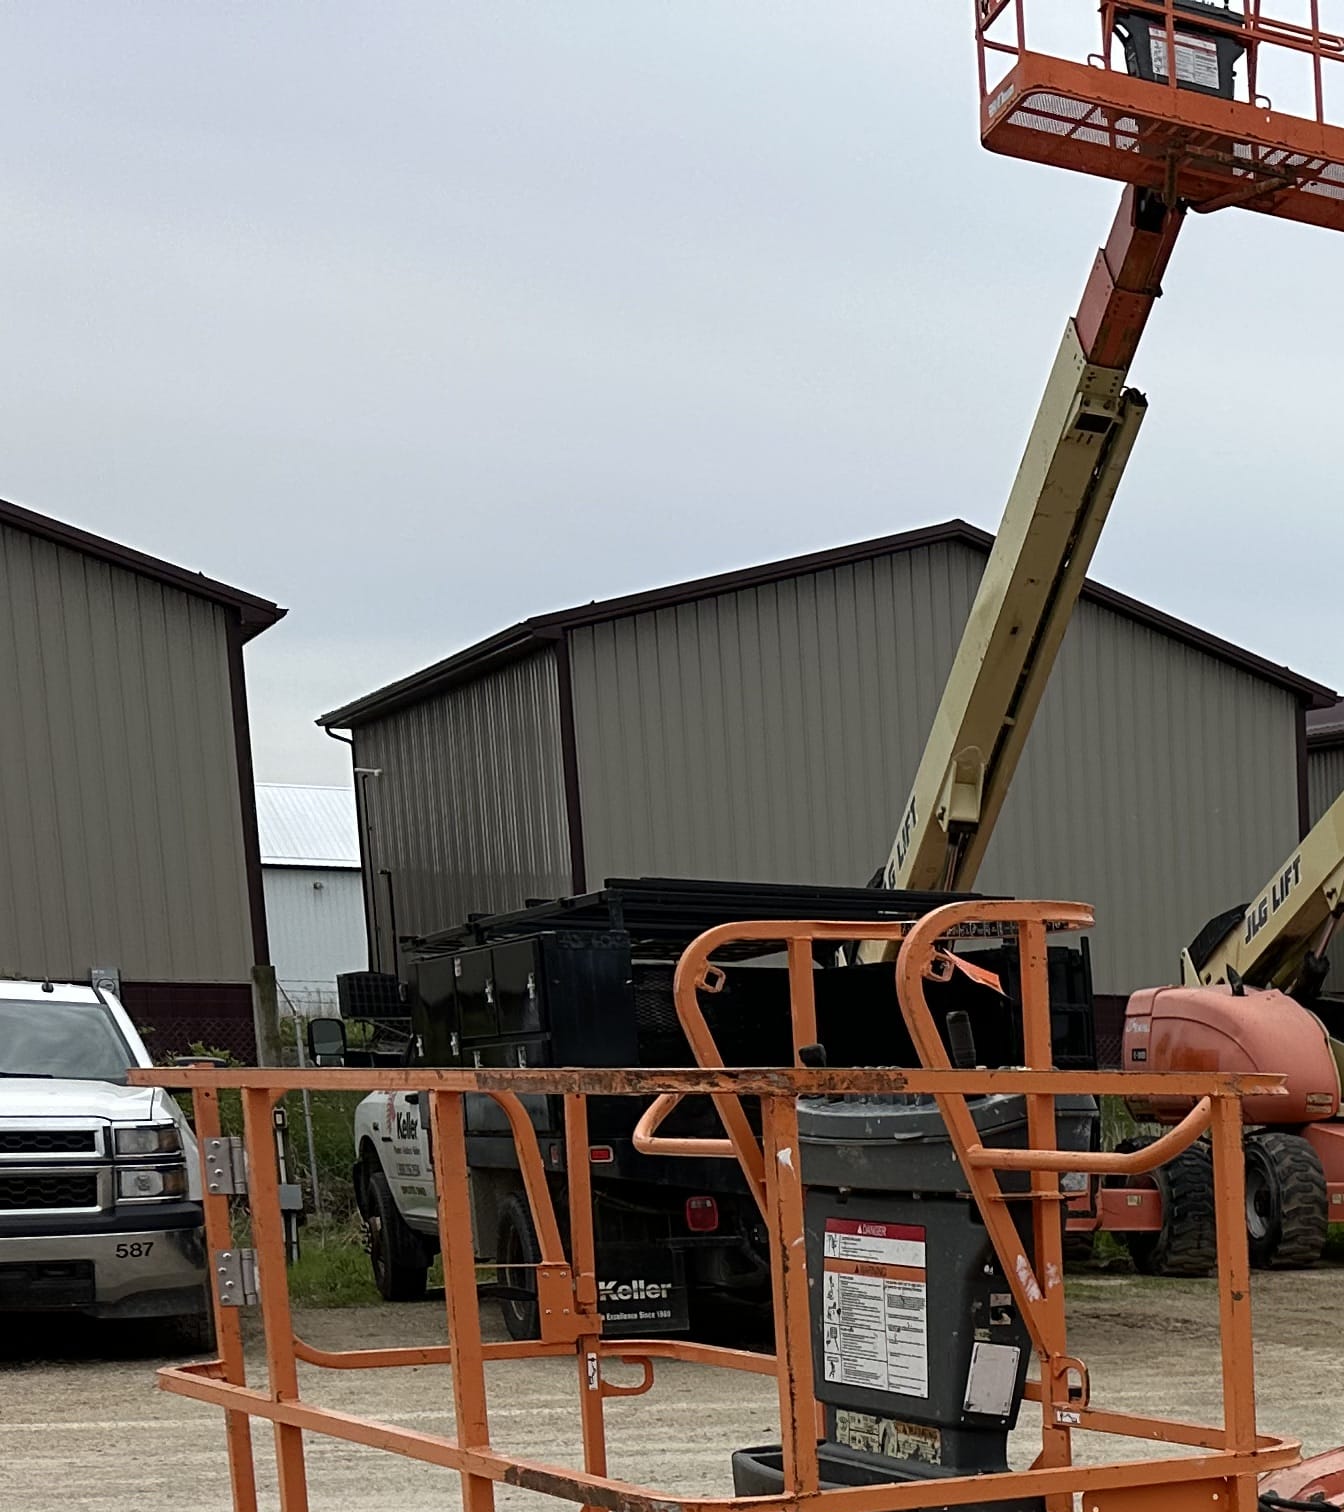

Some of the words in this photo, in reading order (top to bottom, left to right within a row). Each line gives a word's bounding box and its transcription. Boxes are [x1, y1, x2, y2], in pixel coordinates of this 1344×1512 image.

[1244, 895, 1268, 945] JLG
[1272, 853, 1301, 913] LIFT
[115, 1241, 154, 1258] 587
[598, 1280, 672, 1301] Keller
